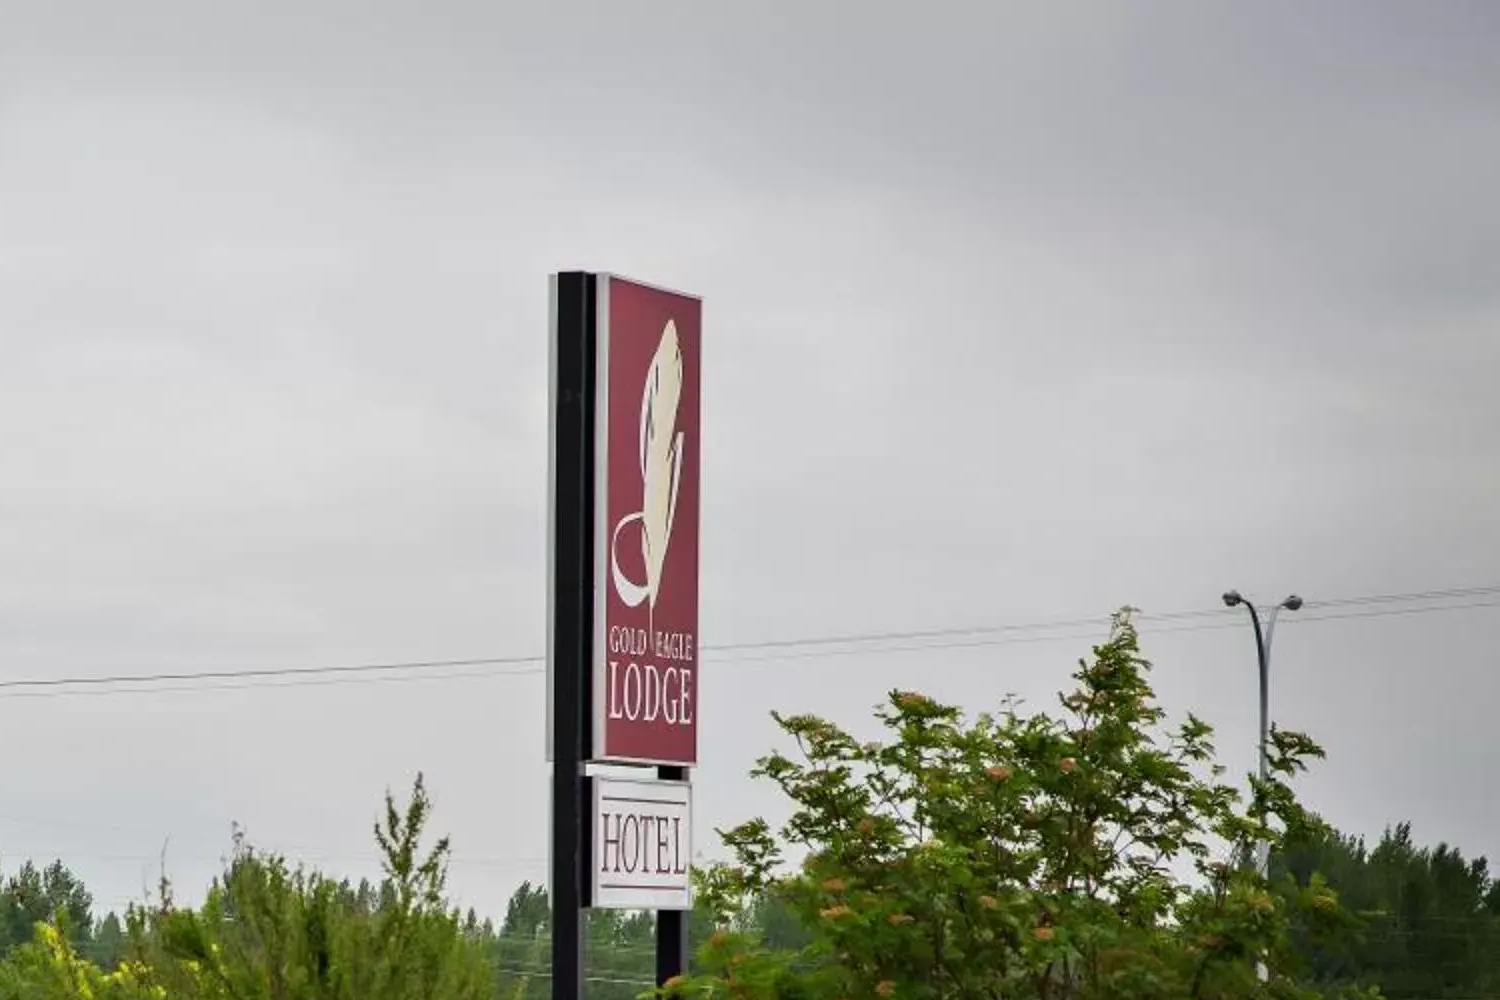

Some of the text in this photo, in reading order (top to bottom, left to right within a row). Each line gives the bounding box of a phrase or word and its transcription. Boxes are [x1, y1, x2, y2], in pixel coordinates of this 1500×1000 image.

[609, 625, 693, 661] GOLD EAGLE
[609, 661, 692, 725] LODGE
[601, 813, 686, 875] HOTEL
